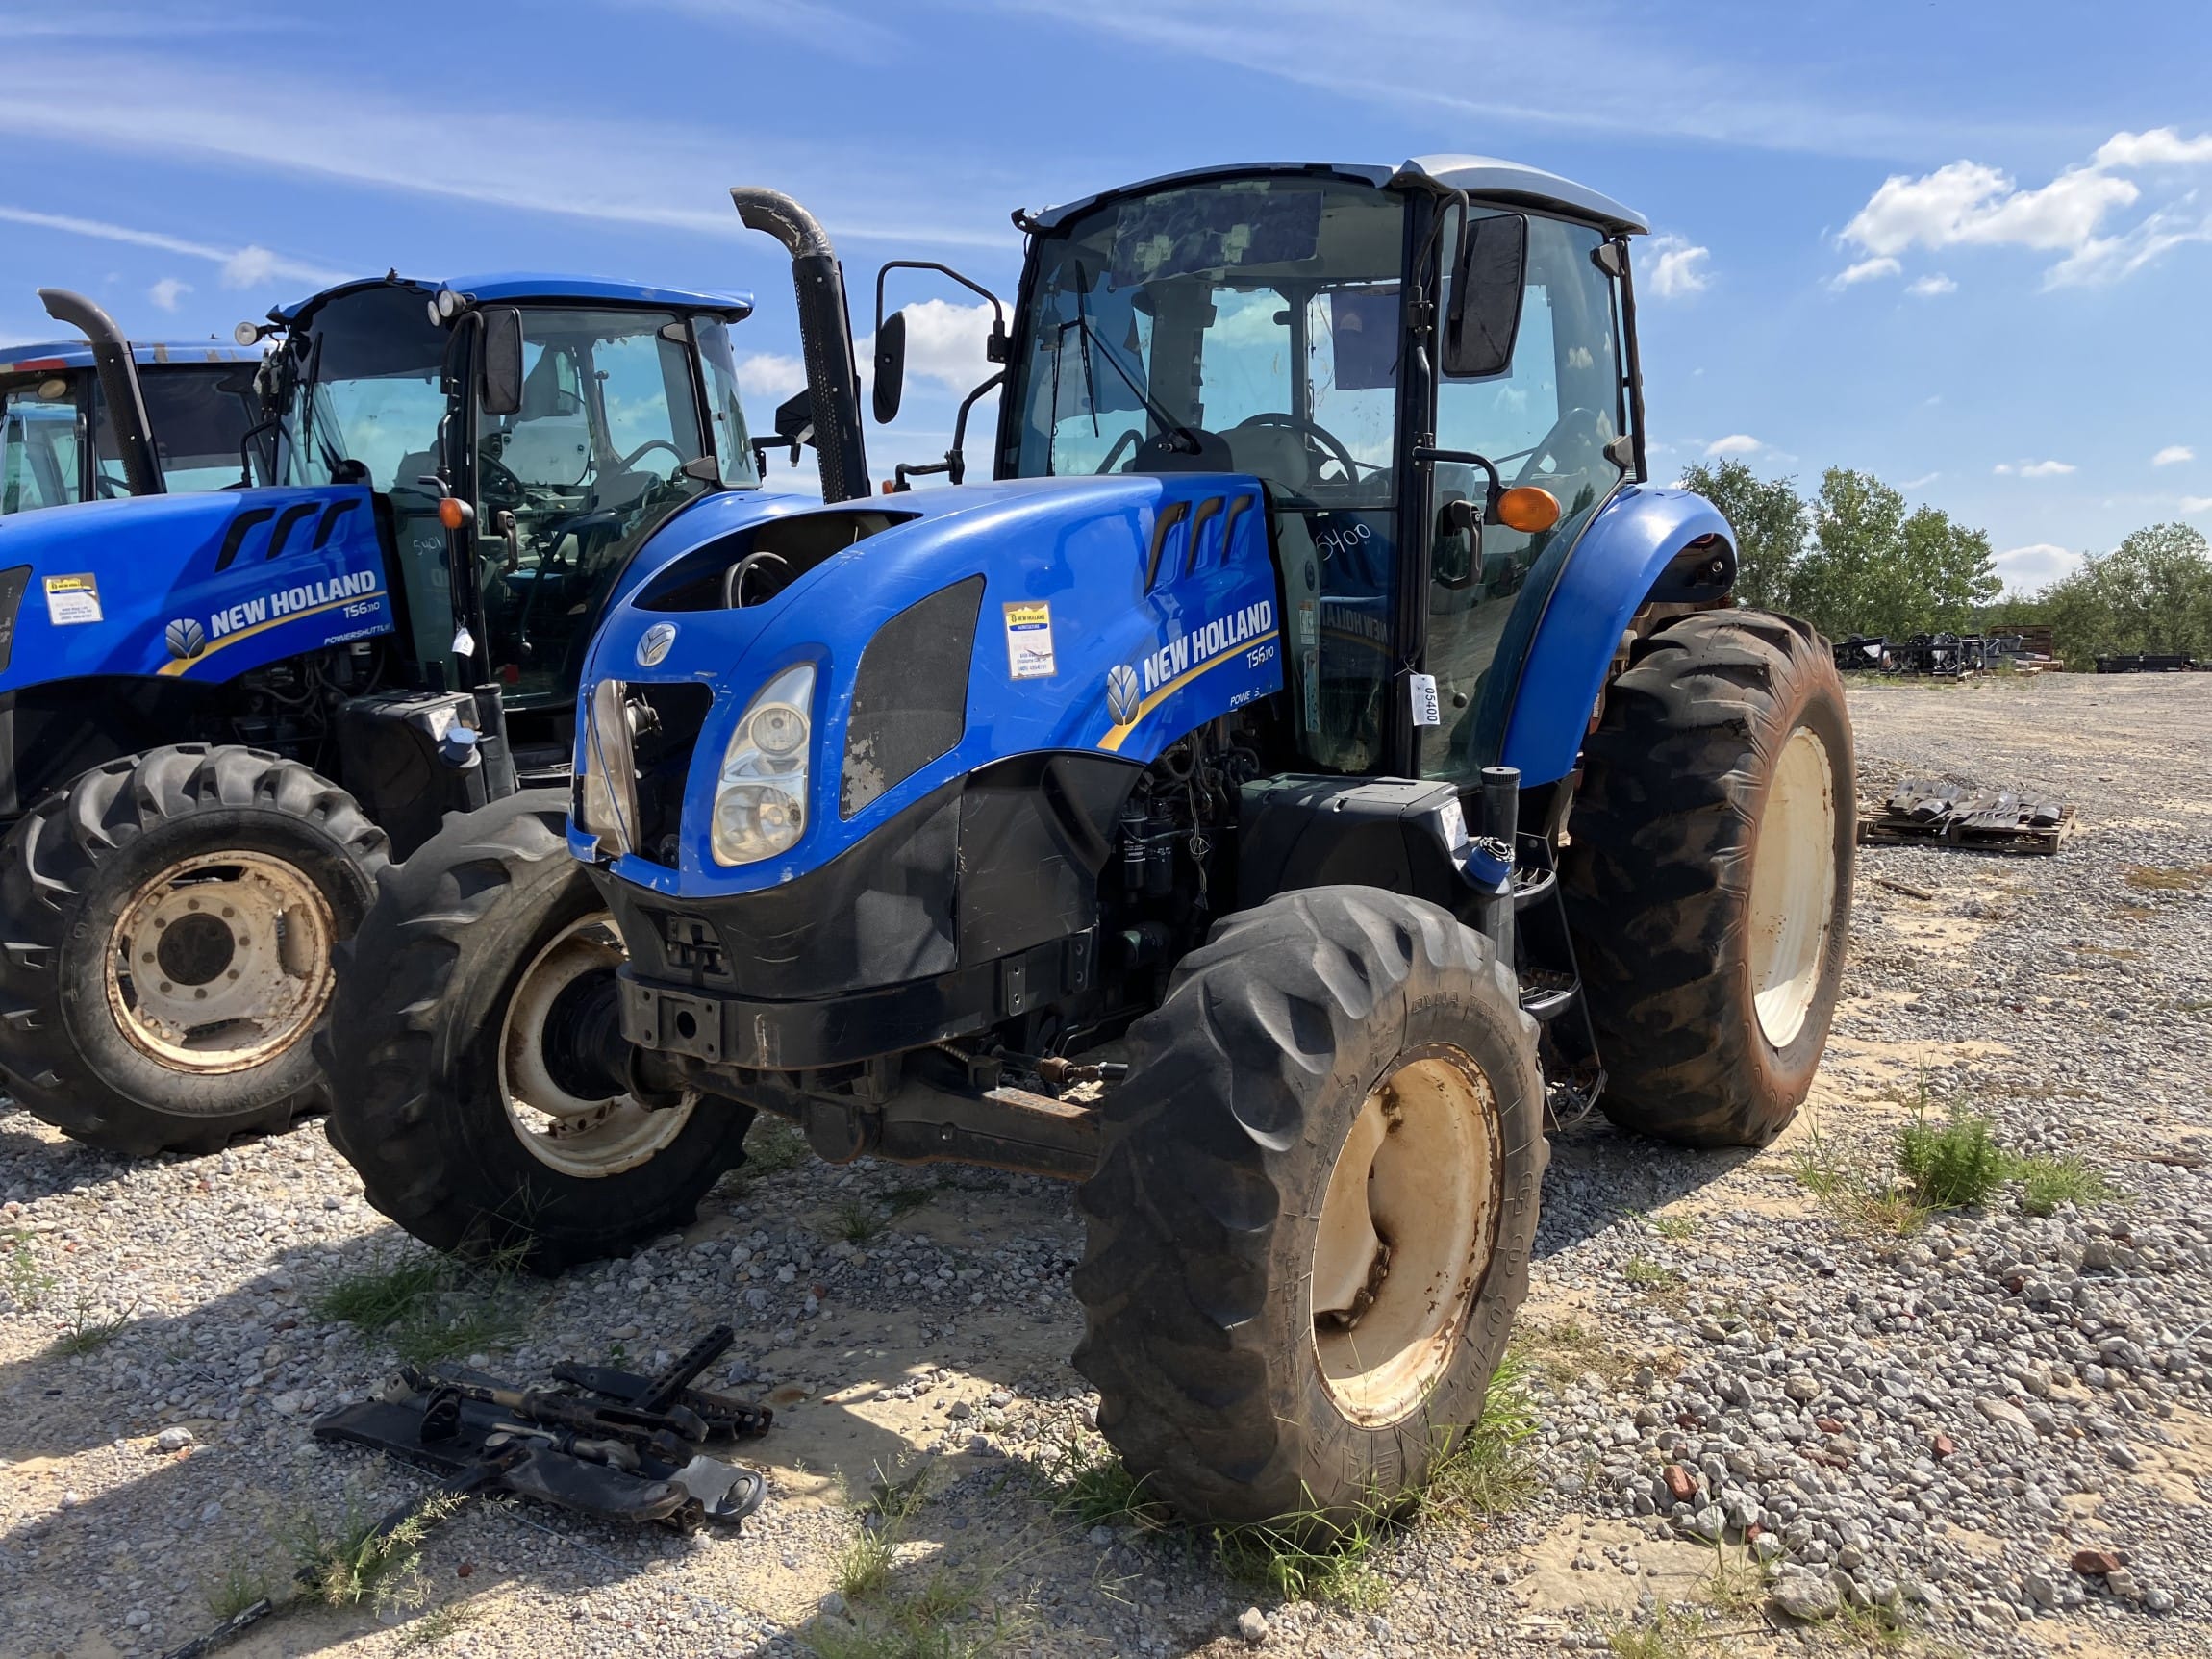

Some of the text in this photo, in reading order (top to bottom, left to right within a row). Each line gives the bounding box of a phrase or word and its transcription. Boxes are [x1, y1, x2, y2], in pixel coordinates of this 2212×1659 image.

[1316, 523, 1370, 561] 5400
[210, 569, 377, 638] NEW HOLLAND
[1144, 635, 1188, 693] NEW
[1192, 599, 1272, 664] HOLLAND
[1424, 687, 1439, 722] 05400
